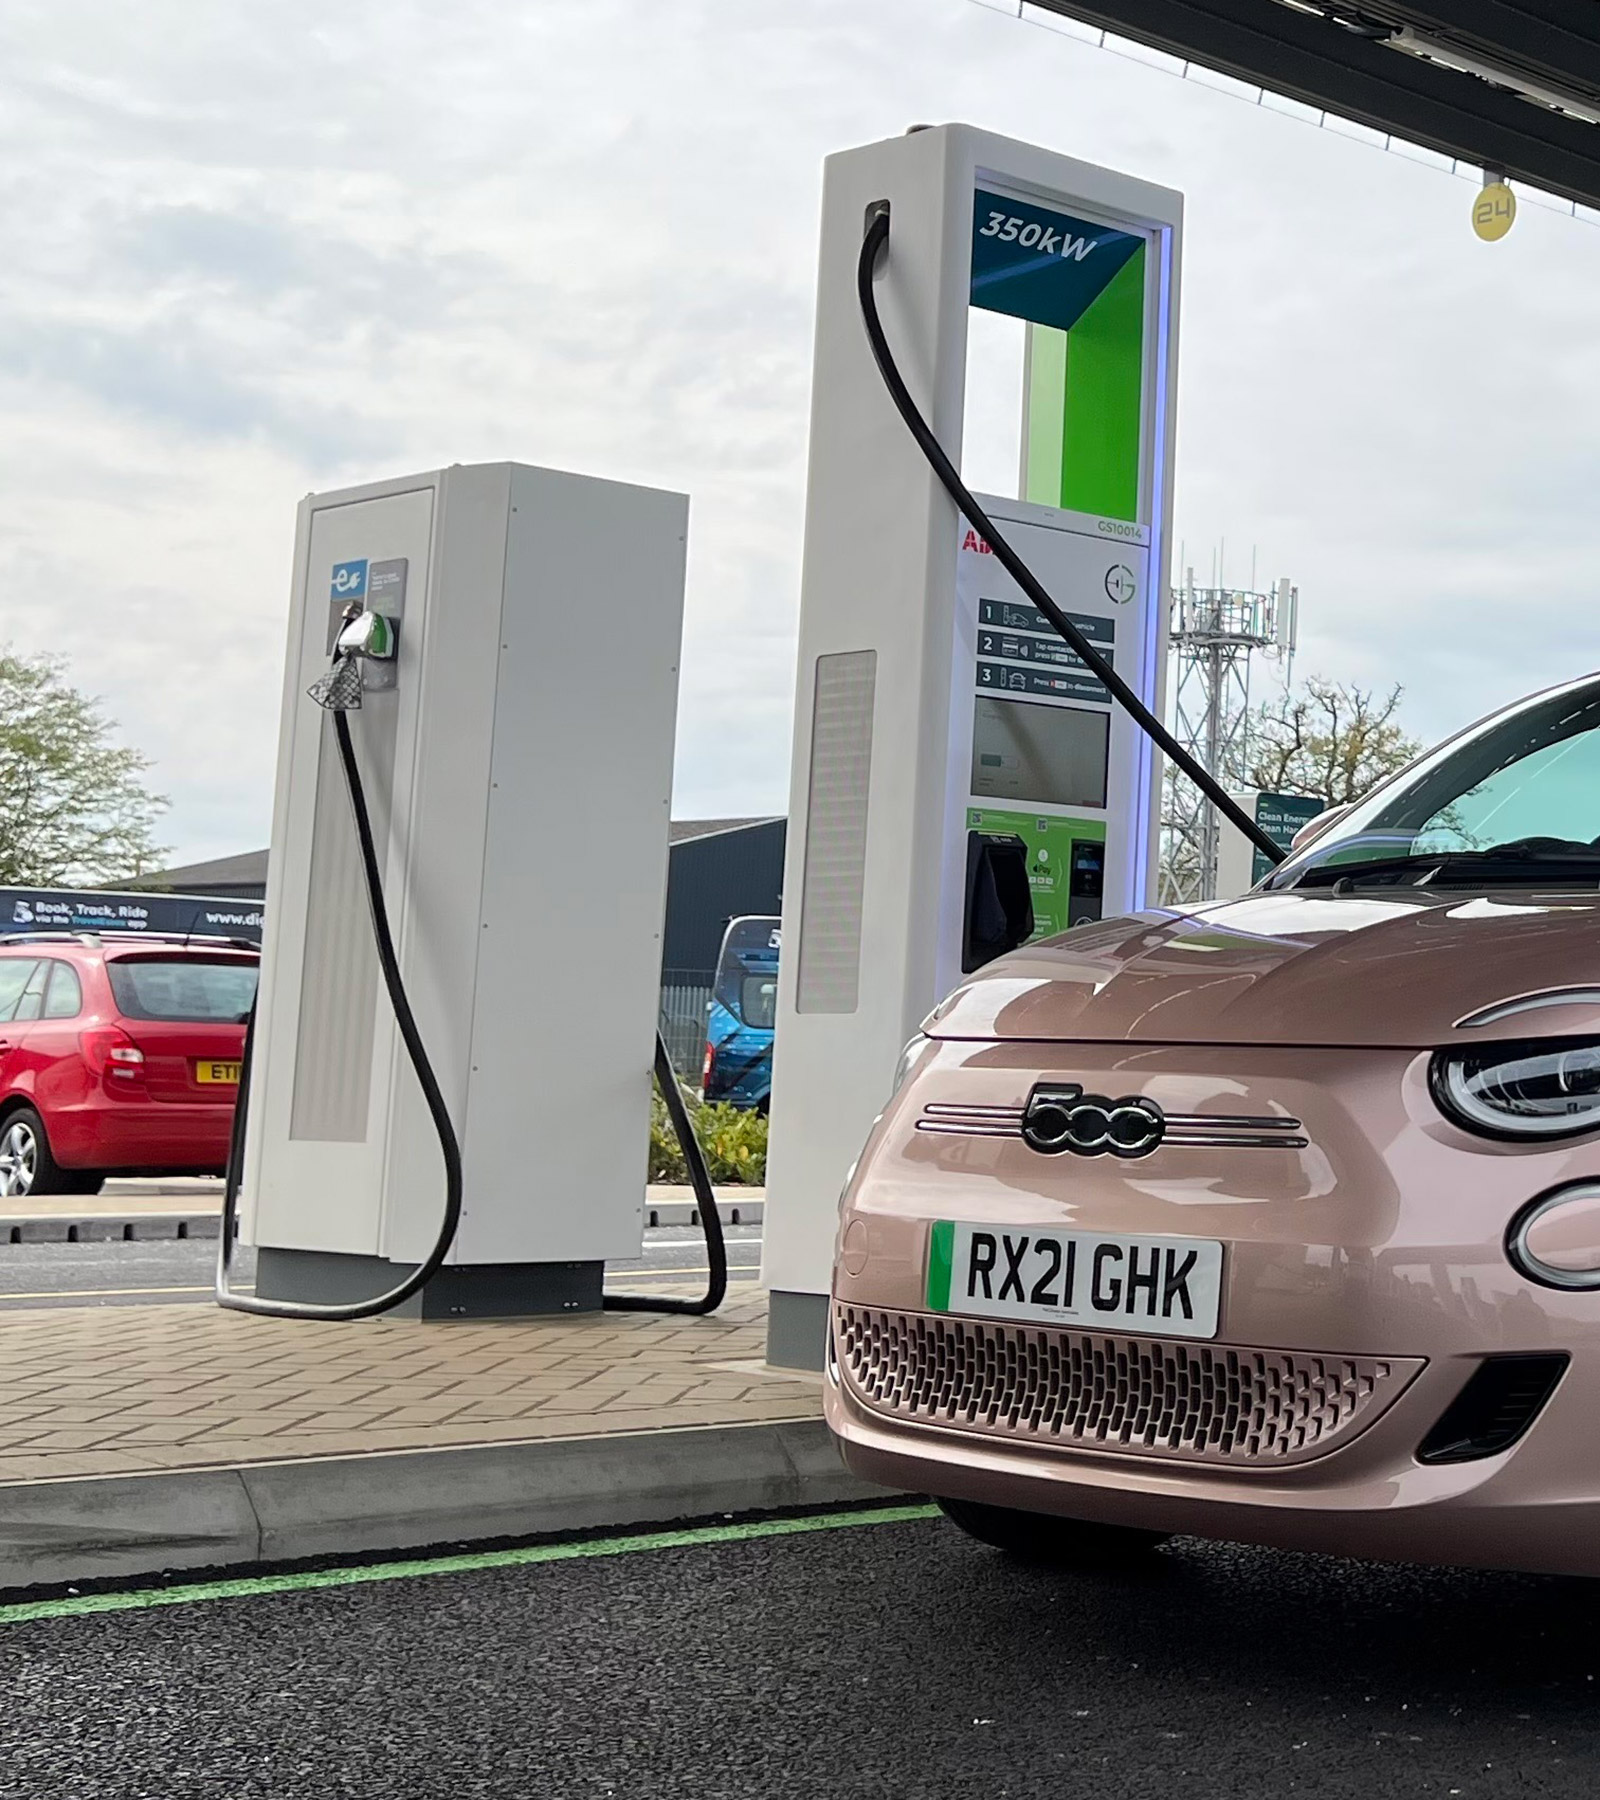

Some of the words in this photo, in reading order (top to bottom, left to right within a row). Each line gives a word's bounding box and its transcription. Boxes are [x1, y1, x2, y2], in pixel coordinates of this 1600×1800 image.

[1477, 198, 1510, 224] 24
[979, 211, 1098, 262] 350kW
[1098, 520, 1142, 539] GS10014
[986, 605, 992, 619] 1
[983, 636, 992, 651] 2
[982, 668, 991, 682] 3
[1258, 811, 1282, 822] Clean
[1259, 822, 1281, 832] Clean
[35, 901, 74, 916] Book,
[75, 904, 117, 918] Track,
[118, 905, 149, 919] Ride
[1024, 1083, 1166, 1158] 500
[967, 1232, 1077, 1308] RX21
[1090, 1243, 1198, 1320] GHK
